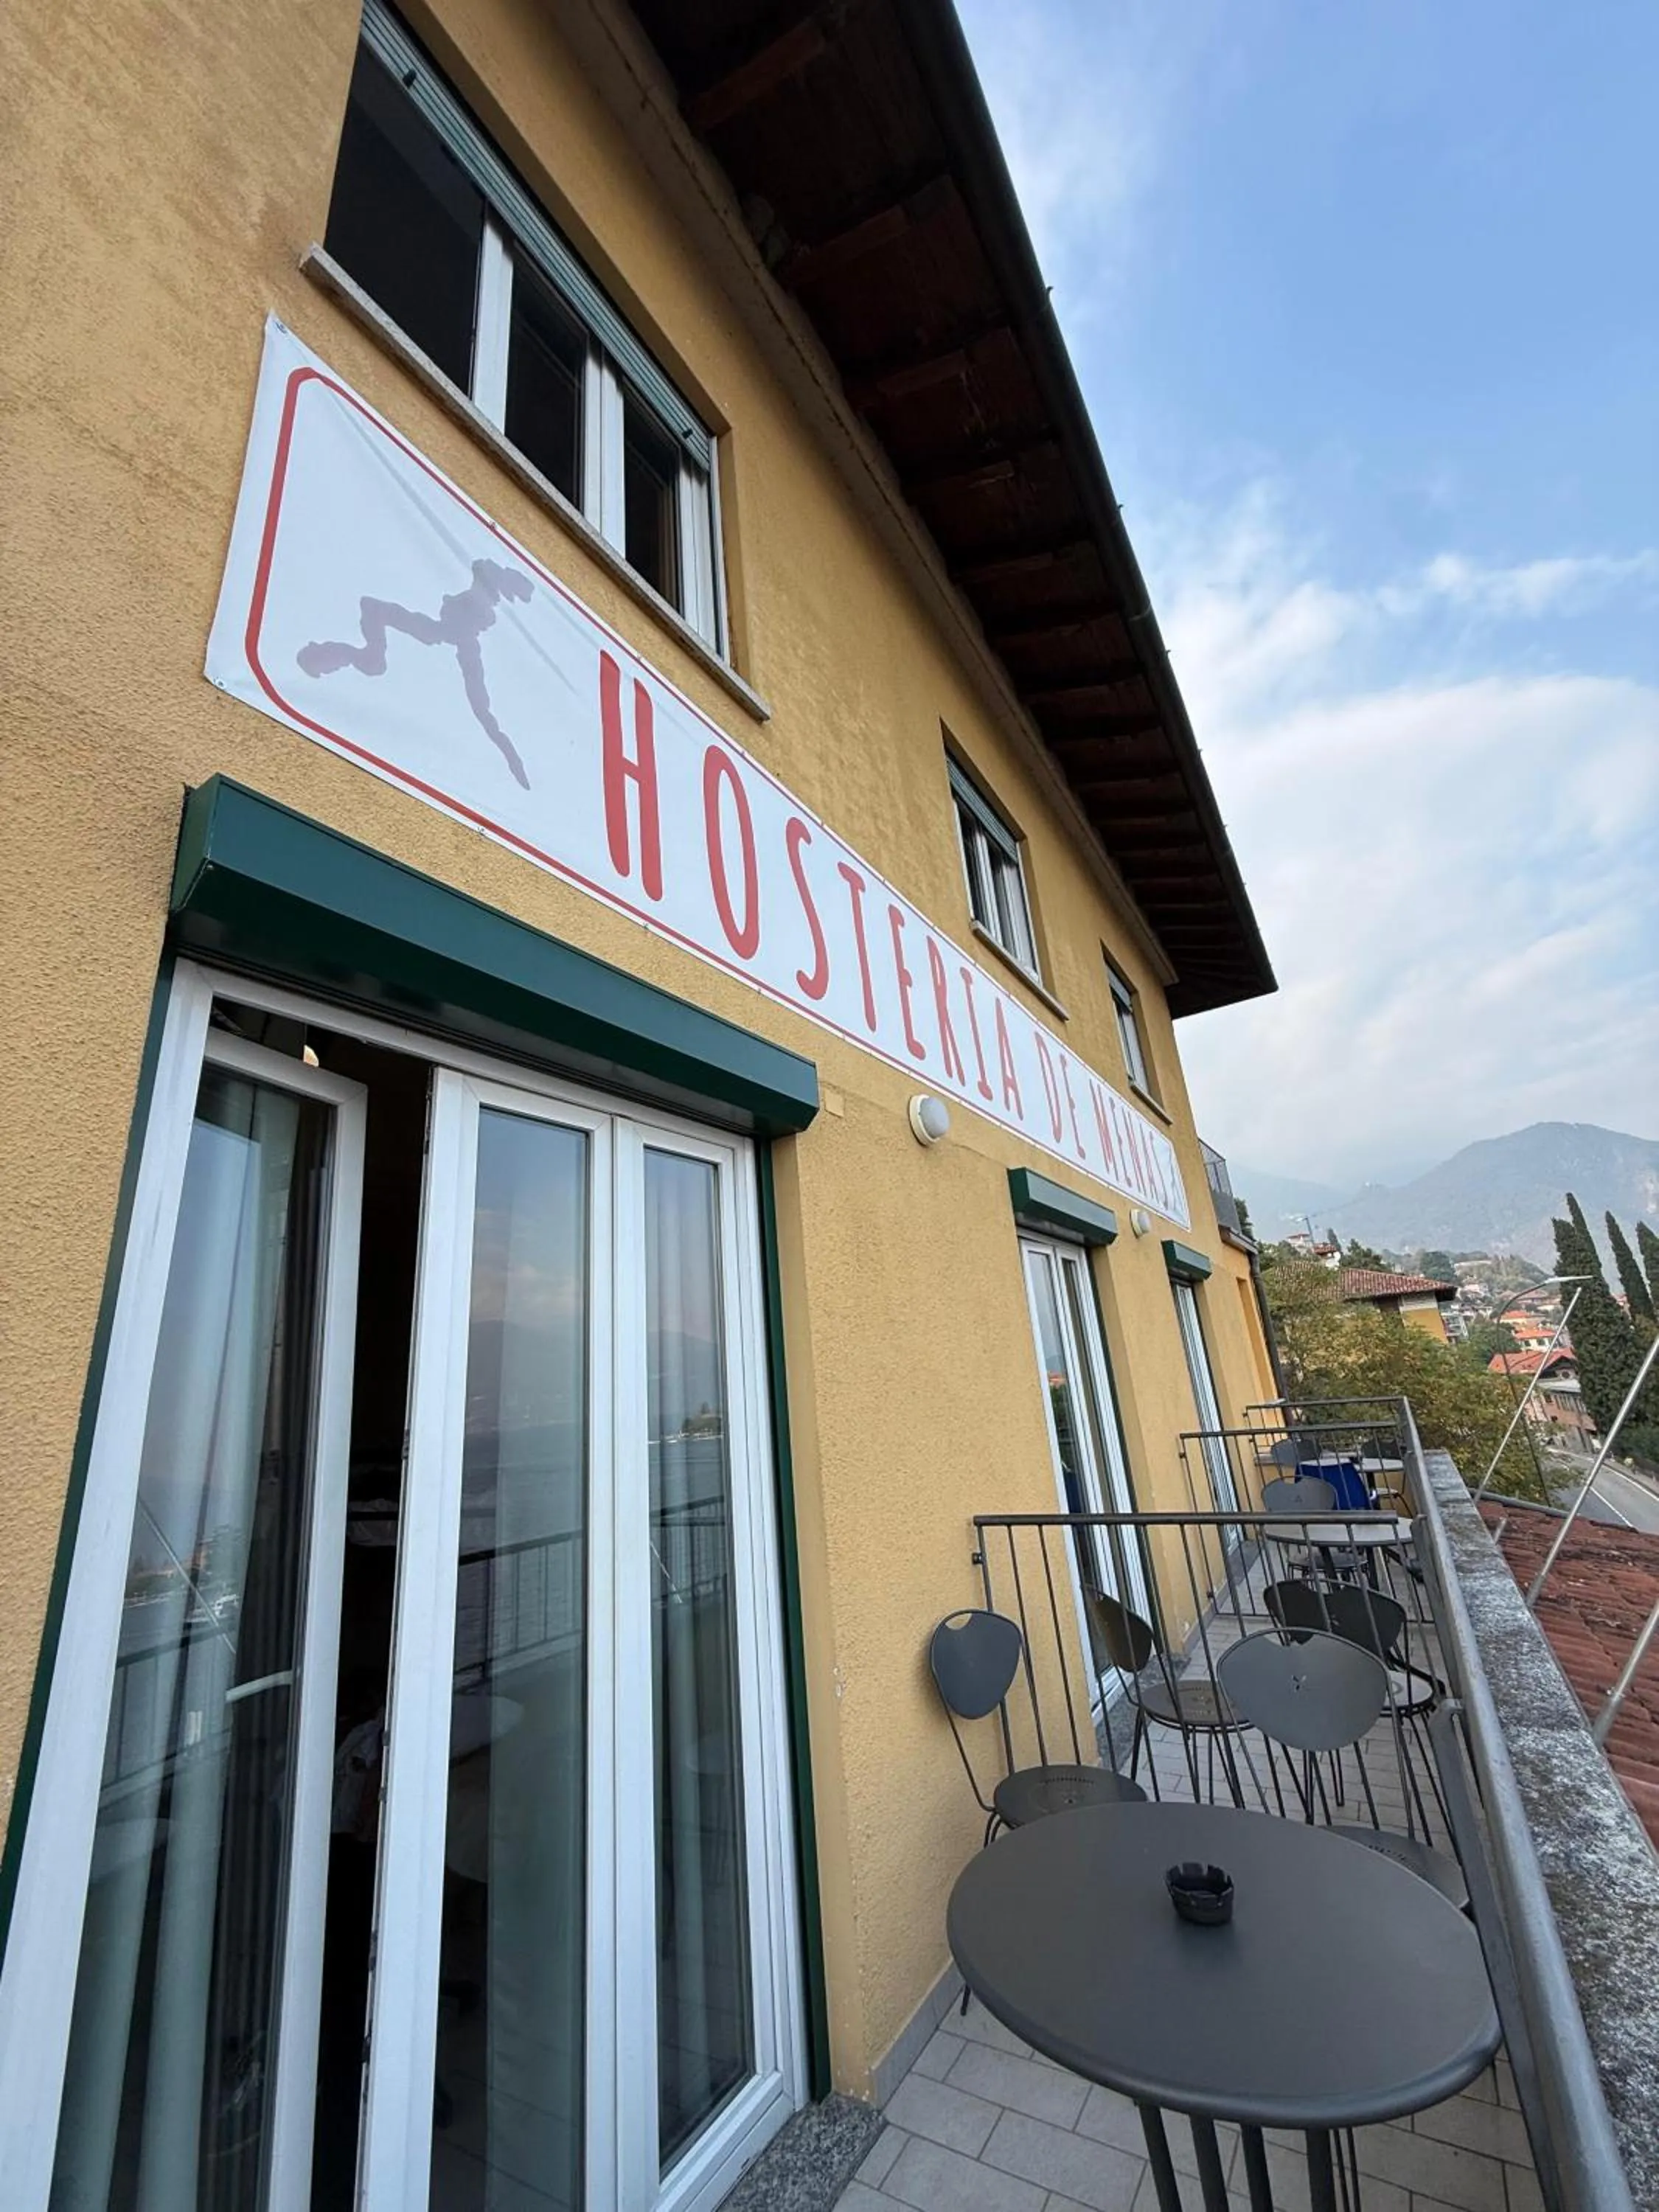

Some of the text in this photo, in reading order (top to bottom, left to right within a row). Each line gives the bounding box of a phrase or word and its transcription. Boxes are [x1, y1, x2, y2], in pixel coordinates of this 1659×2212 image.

[599, 648, 1169, 1211] HOSTERIA DE MENAS
